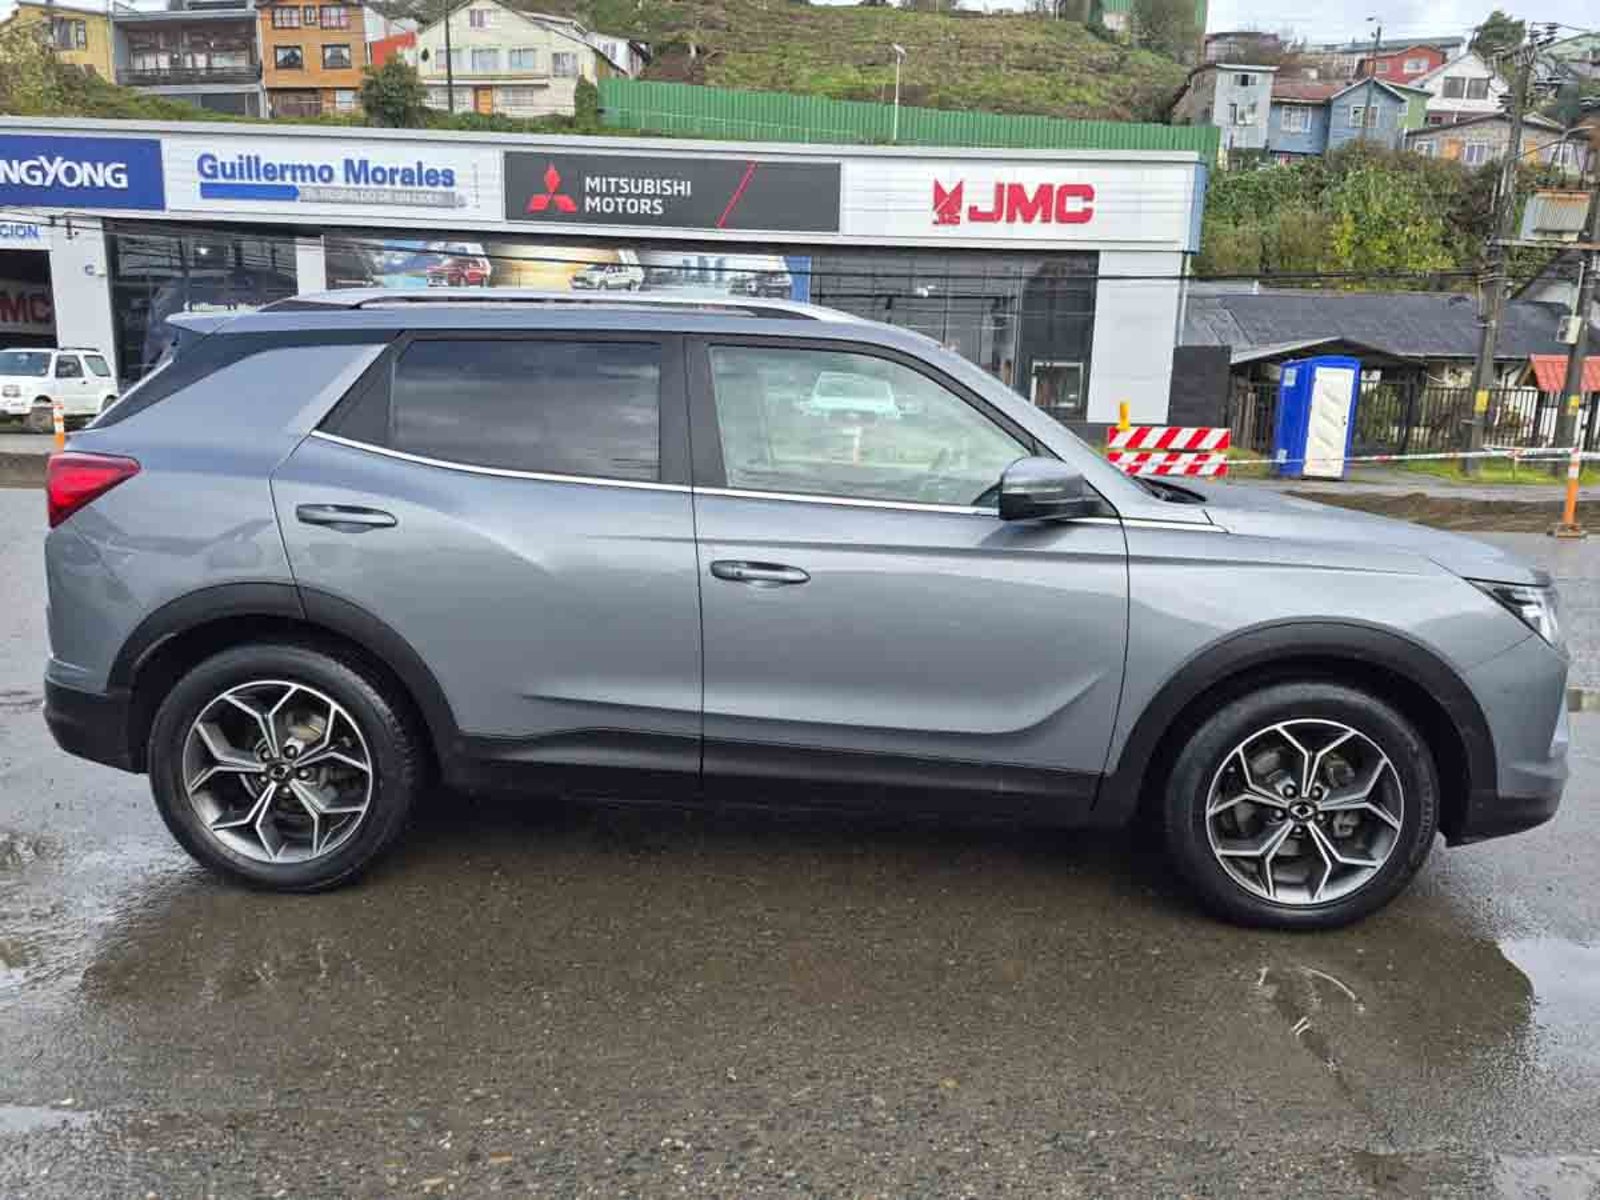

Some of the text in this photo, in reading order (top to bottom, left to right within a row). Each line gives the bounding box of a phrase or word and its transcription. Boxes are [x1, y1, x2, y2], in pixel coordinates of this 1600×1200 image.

[197, 154, 456, 187] Guillermo Morales
[585, 176, 691, 196] MITSUBISHI
[585, 196, 664, 214] MOTORS
[968, 183, 1095, 223] JMC
